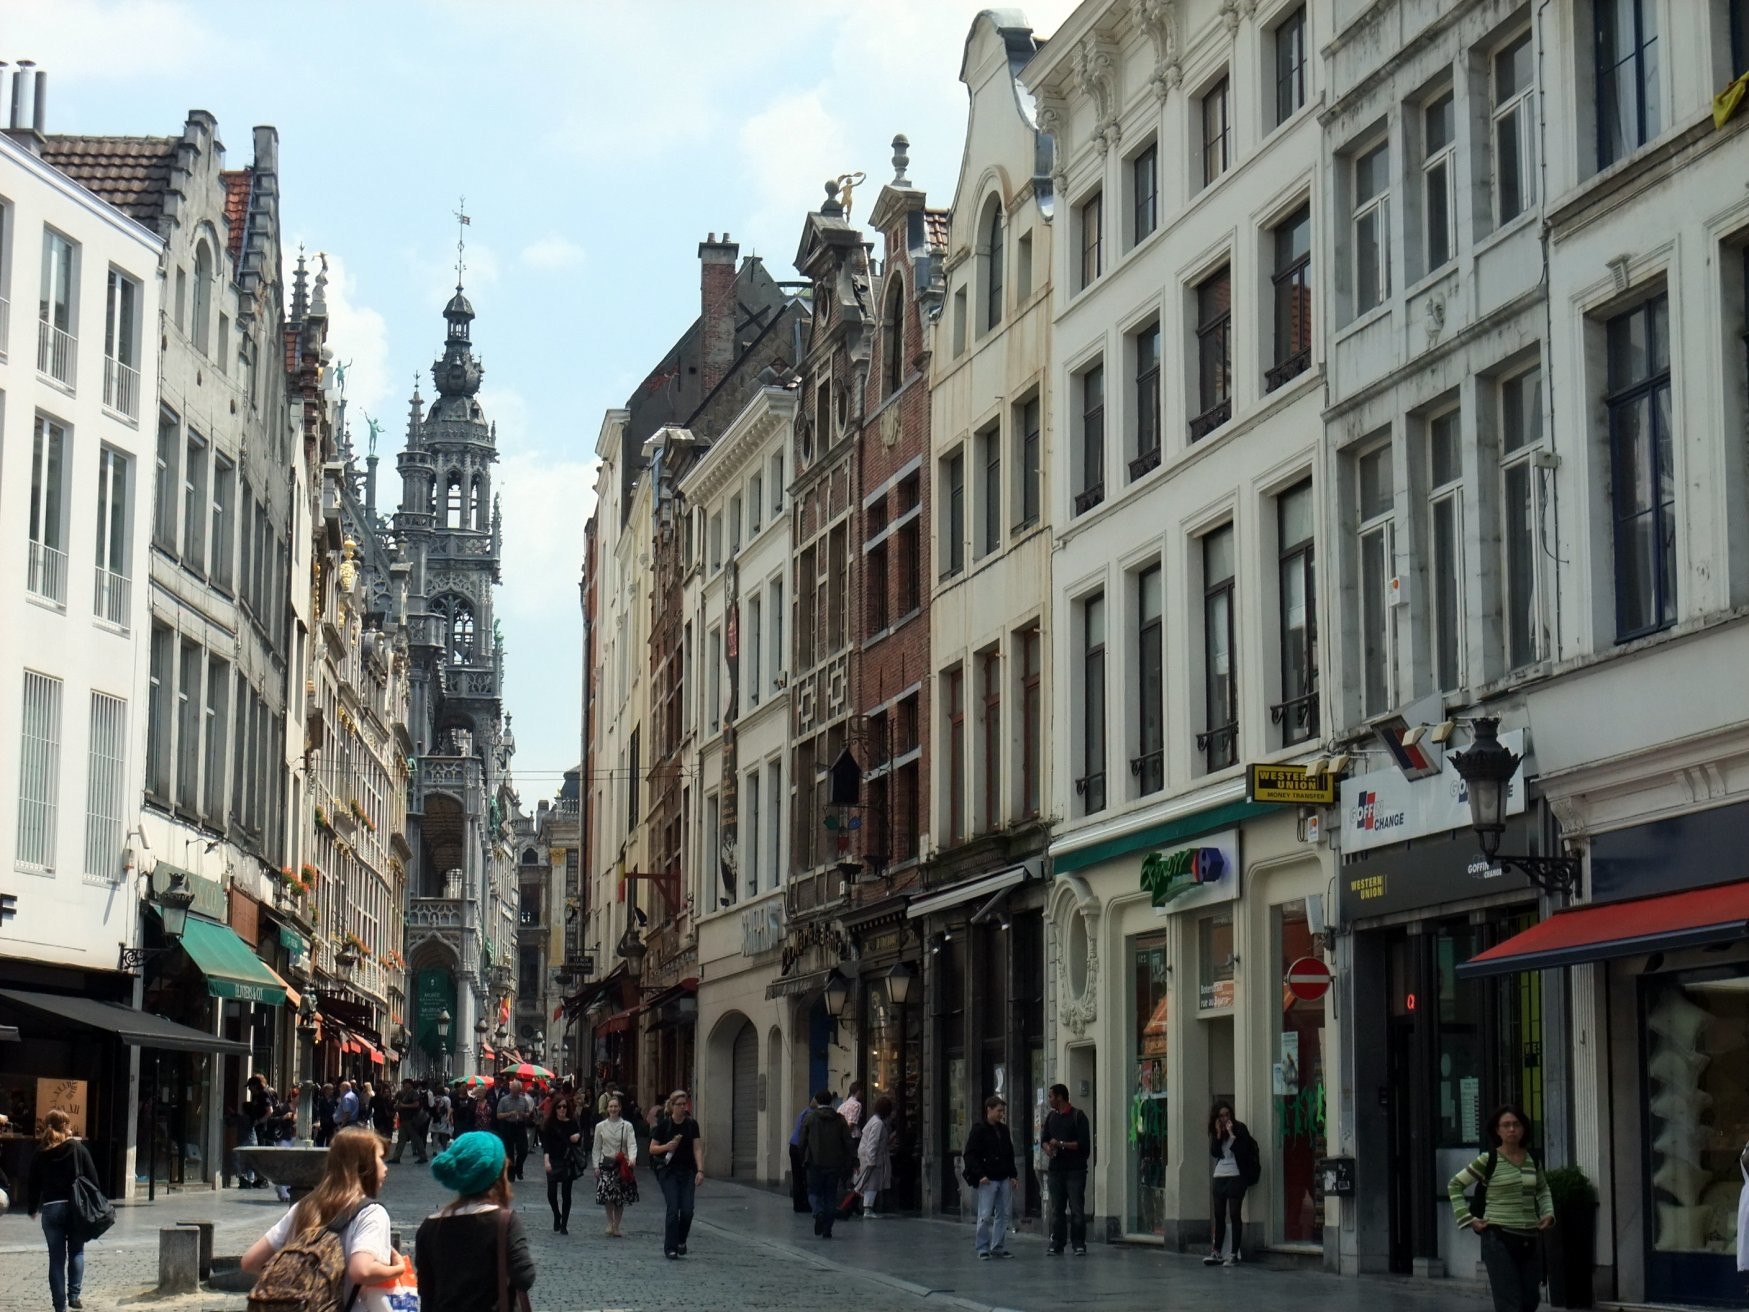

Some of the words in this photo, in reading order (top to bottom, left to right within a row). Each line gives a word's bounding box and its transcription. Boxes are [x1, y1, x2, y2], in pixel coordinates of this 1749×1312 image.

[1259, 771, 1317, 782] WESTER
[1277, 780, 1317, 790] UNION
[1350, 800, 1384, 824] GOFFIN
[1374, 812, 1404, 831] CHANGE
[1467, 861, 1490, 874] GOFFIN
[1350, 874, 1384, 892] WESTERN
[1360, 886, 1384, 900] UNION
